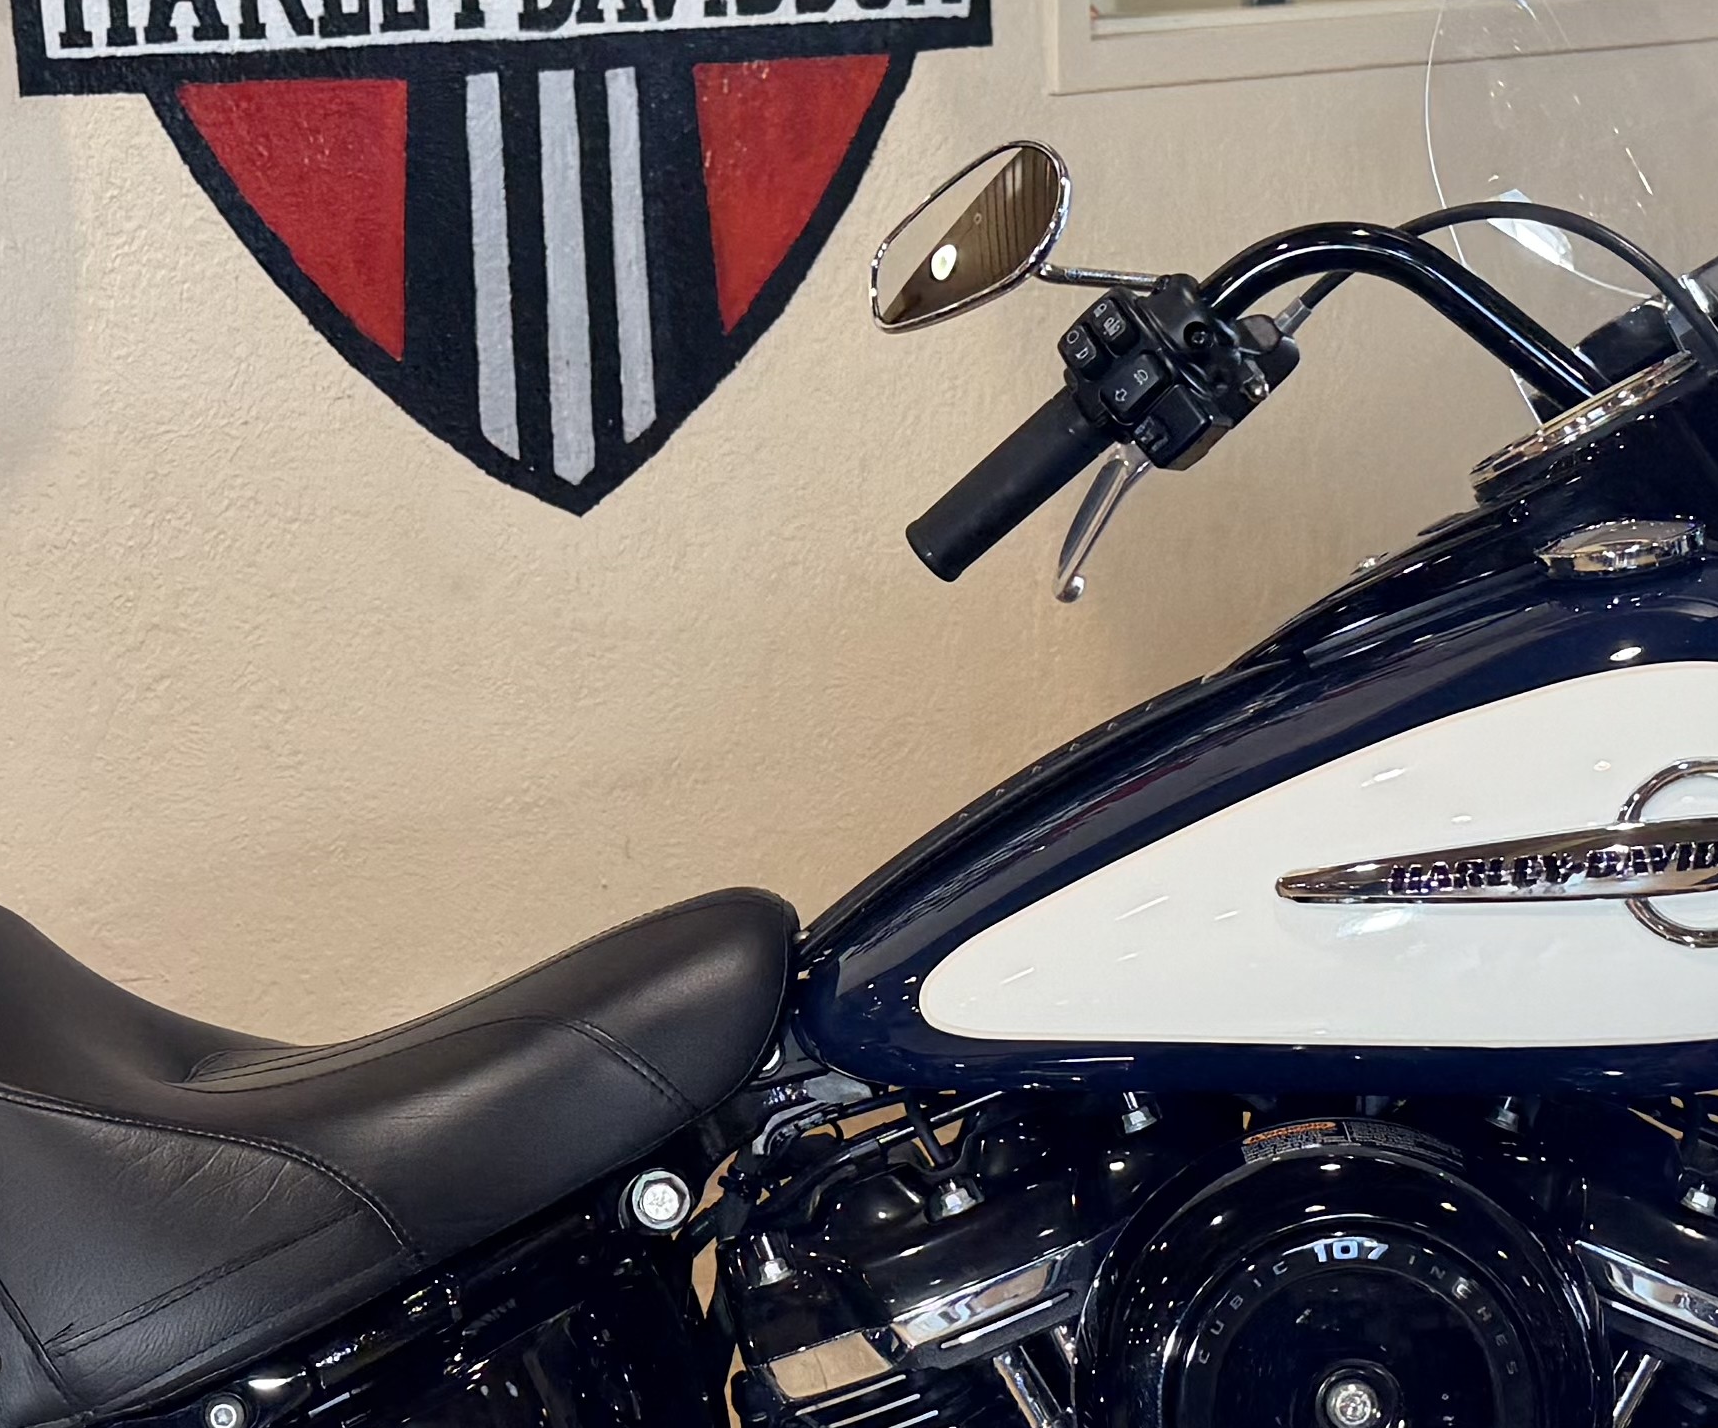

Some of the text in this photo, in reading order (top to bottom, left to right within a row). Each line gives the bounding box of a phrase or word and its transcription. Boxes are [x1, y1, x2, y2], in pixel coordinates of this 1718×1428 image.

[1198, 1237, 1519, 1376] CUBIC 107 INCHES
